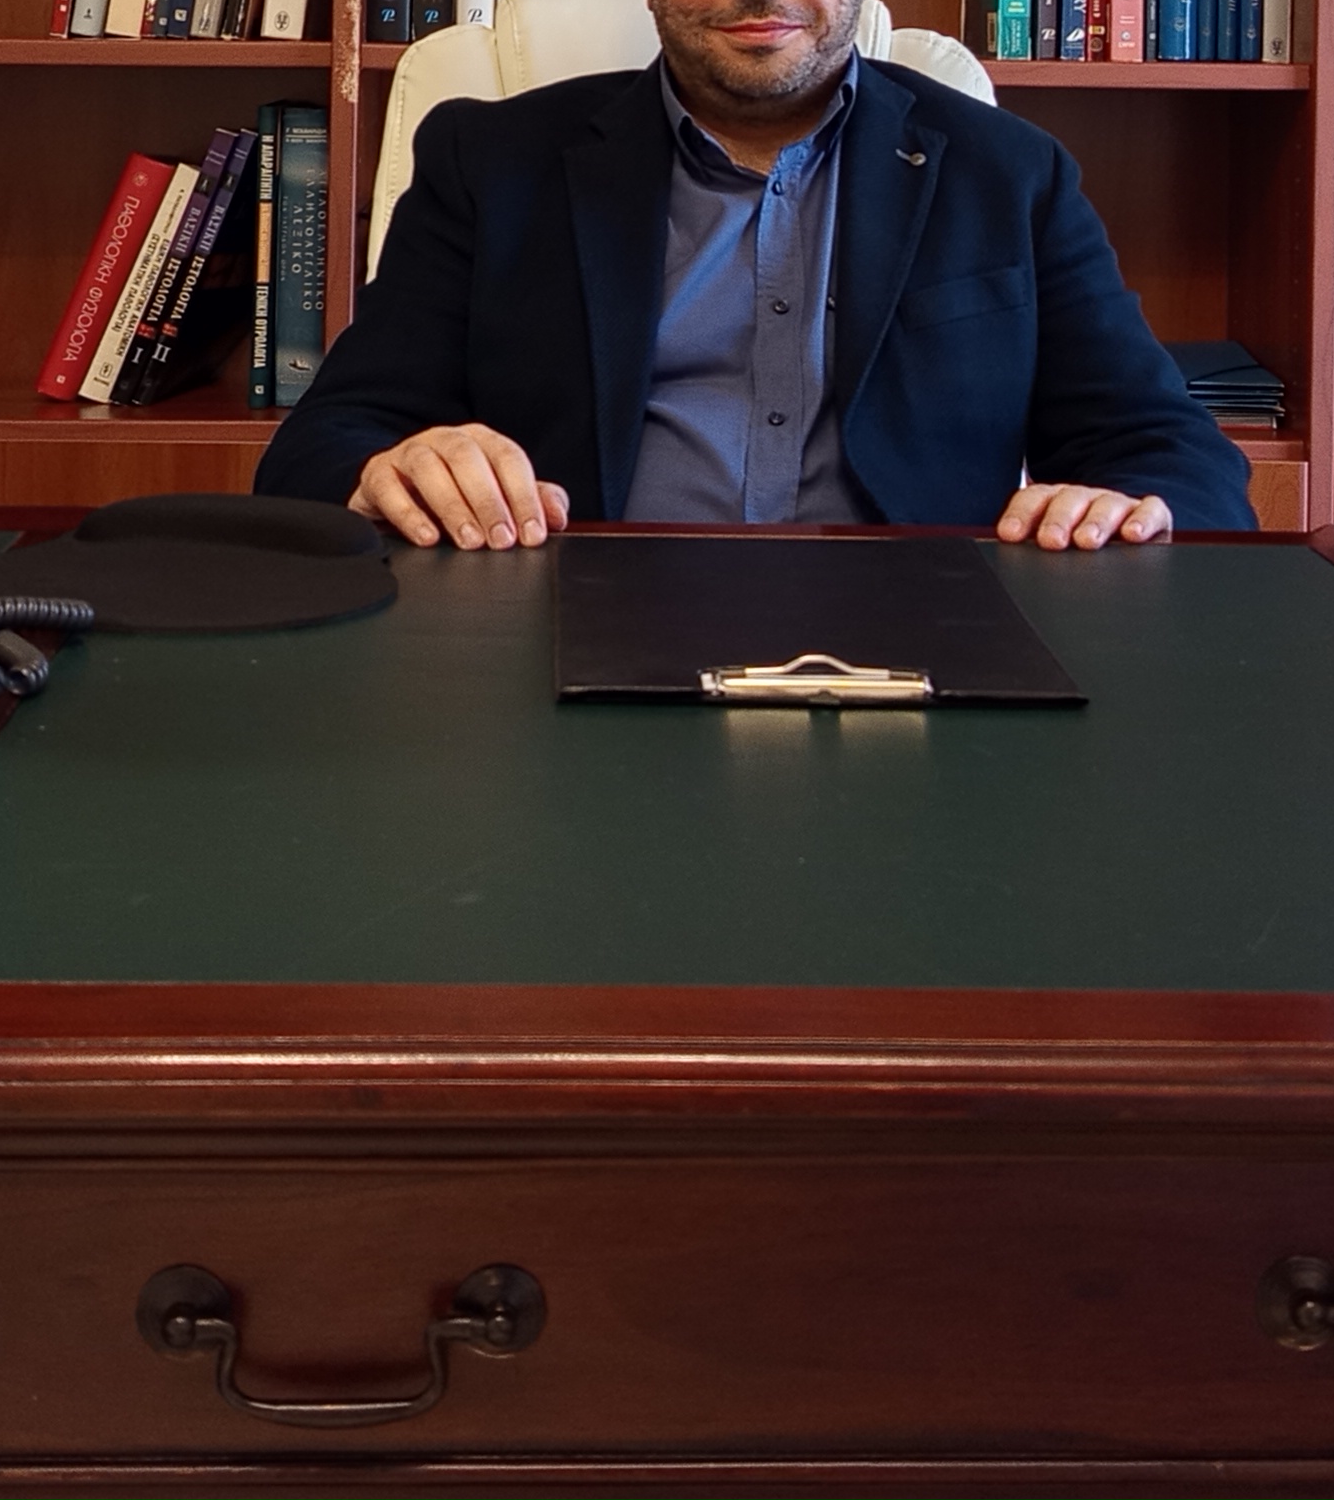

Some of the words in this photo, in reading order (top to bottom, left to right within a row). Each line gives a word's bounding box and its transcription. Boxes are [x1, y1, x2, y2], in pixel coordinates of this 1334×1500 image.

[93, 194, 141, 284] ΠΑΘΟΛΟΓΙΚΗ
[174, 206, 201, 253] ΒΑΣΙΚΗ
[198, 204, 225, 253] ΒΑΣΙΚΗ
[146, 257, 183, 322] ΙΣΤΟΛΟΓΙΑ
[169, 255, 206, 320] ΙΣΤΟΛΟΓΙΑ
[255, 285, 269, 317] ΓΕΝΙΚΗ
[61, 285, 105, 363] ΦΥΣΙΟΛΟΓΙΑ
[253, 318, 268, 369] ΟΥΡΟΛΟΓΙΑ
